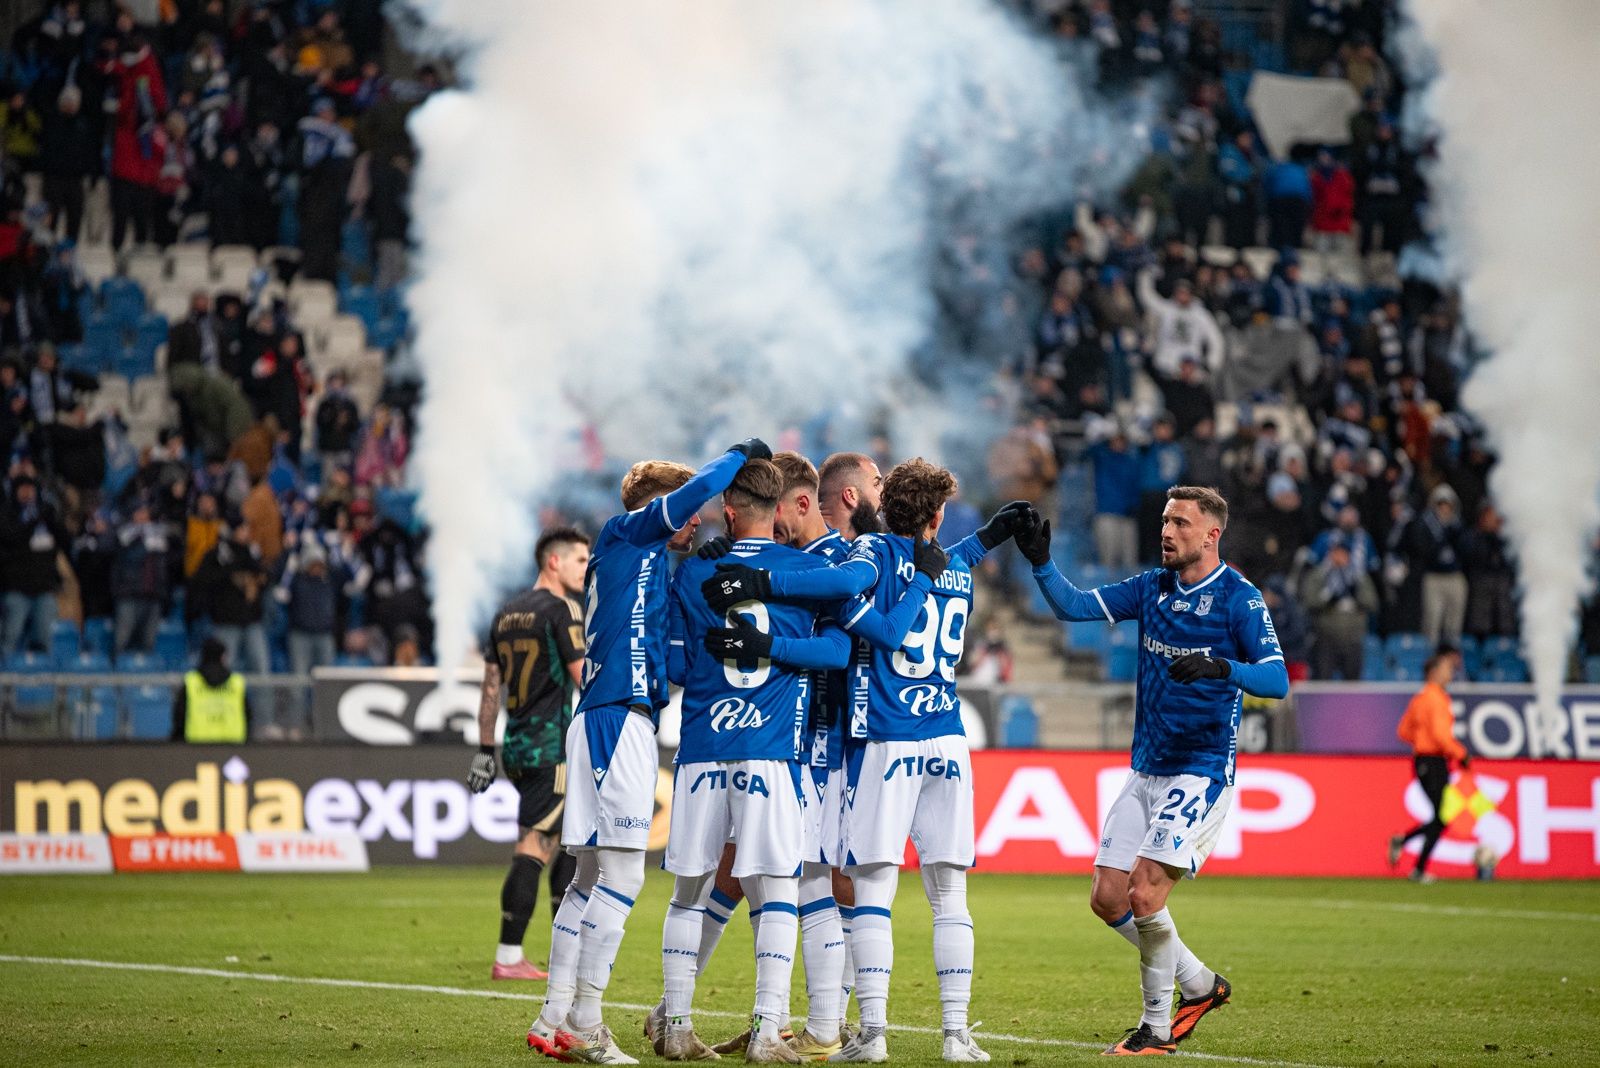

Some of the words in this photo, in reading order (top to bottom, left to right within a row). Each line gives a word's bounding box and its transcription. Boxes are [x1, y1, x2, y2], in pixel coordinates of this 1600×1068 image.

[892, 592, 968, 682] 99
[497, 639, 539, 707] 27
[709, 697, 771, 733] Pils
[690, 770, 769, 799] STIGA
[883, 756, 961, 782] STIGA
[1158, 788, 1201, 828] 24
